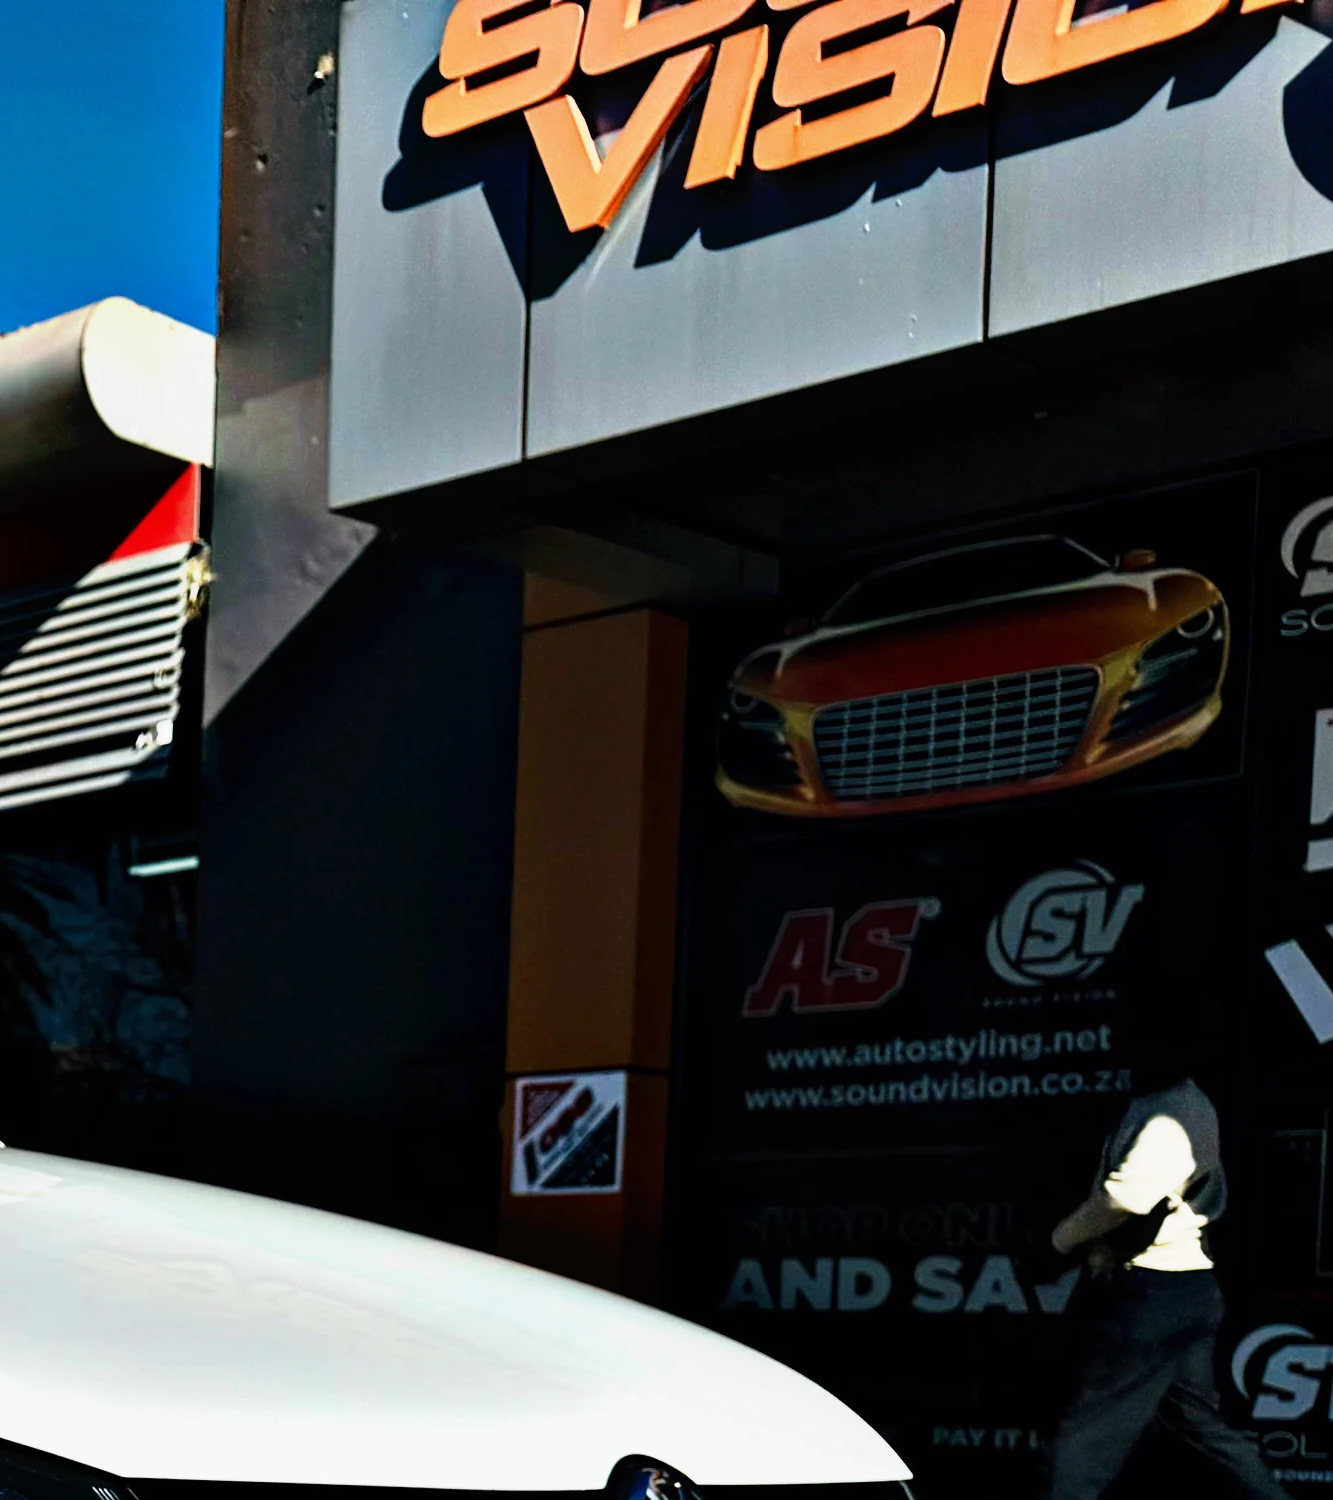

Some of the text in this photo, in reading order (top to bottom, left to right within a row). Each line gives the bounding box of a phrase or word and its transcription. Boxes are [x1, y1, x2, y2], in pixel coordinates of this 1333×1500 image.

[765, 1022, 1113, 1073] www.autostyling.net
[723, 1254, 894, 1312] AND
[932, 1425, 988, 1449] PAY
